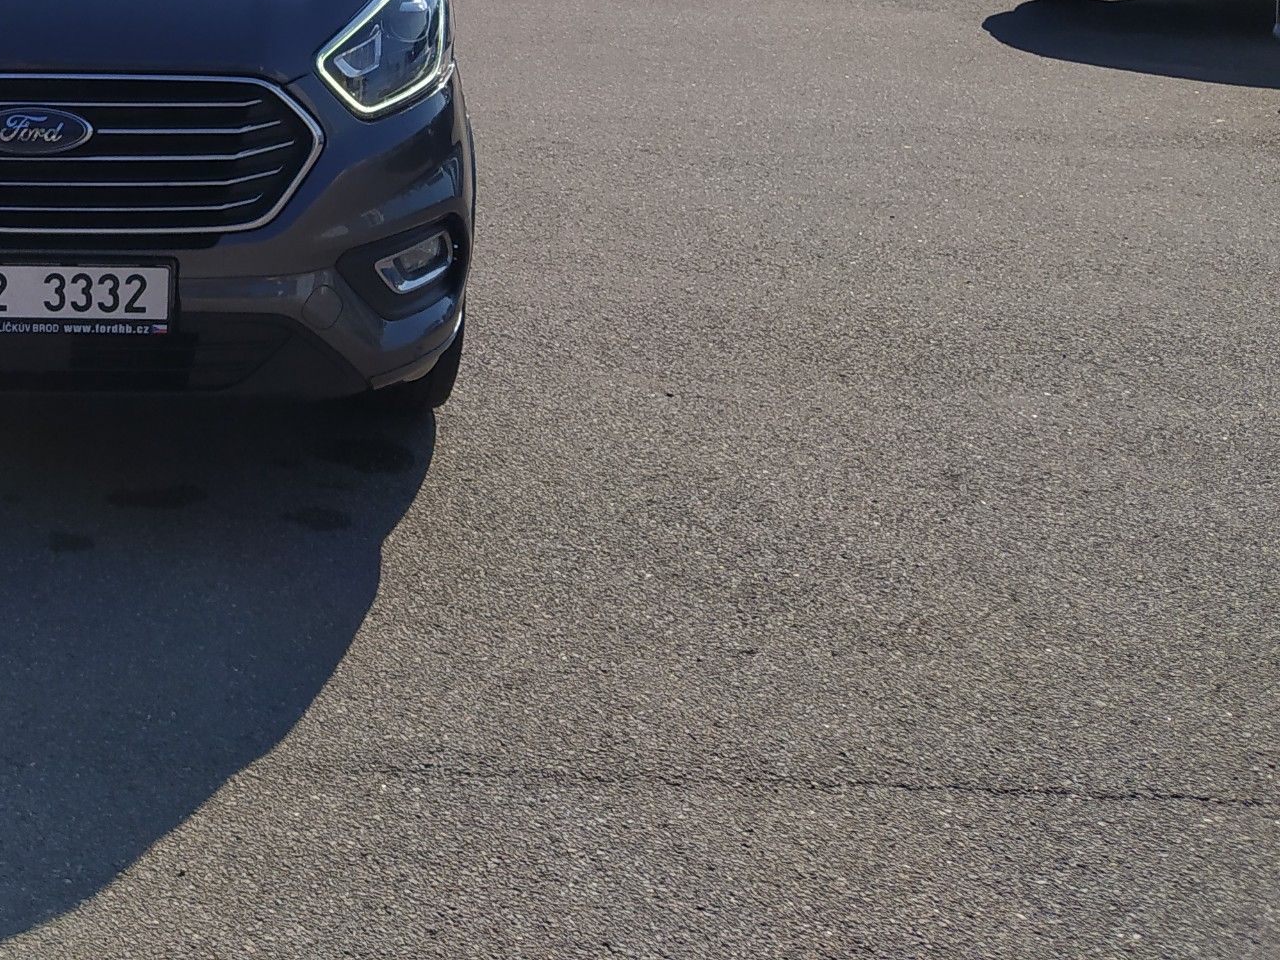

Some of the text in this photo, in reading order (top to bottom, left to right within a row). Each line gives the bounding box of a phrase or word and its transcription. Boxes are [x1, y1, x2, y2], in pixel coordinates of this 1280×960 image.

[0, 114, 64, 142] Ford
[43, 272, 148, 314] 3332
[32, 323, 60, 333] BROD
[63, 323, 150, 334] www.fordhb.cz
